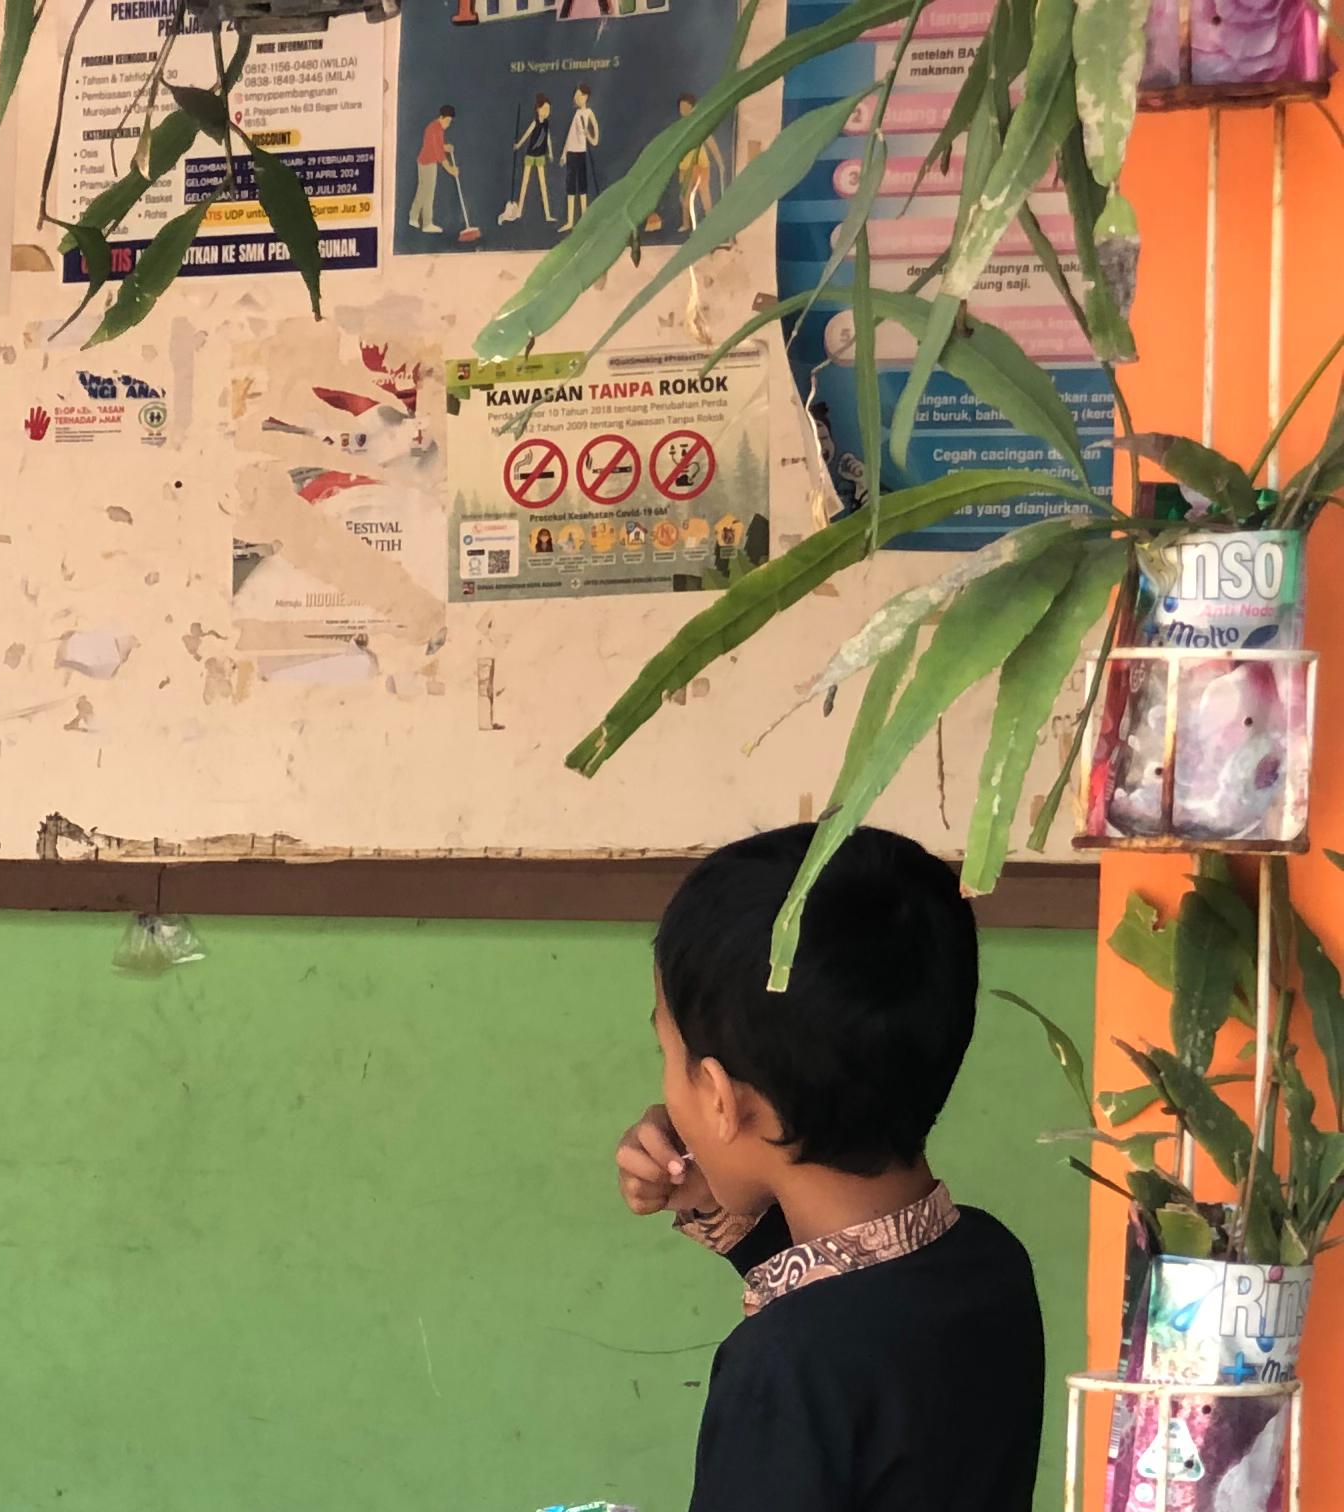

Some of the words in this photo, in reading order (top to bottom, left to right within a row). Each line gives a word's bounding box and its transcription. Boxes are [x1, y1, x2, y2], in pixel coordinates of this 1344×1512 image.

[911, 48, 955, 61] setelah
[957, 46, 981, 59] BA
[319, 56, 358, 70] (WILDA)
[325, 69, 355, 82] (MILA)
[910, 65, 965, 78] makanan
[238, 242, 266, 263] SMK
[1006, 278, 1032, 291] saji.
[486, 384, 584, 407] KAWASAN
[588, 380, 655, 400] TANPA
[659, 375, 729, 397] ROKOK
[561, 407, 589, 417] Tahun
[613, 404, 649, 415] tentang
[650, 400, 700, 411] Perubahan
[701, 397, 728, 408] Perda
[54, 416, 97, 426] TERHADAP
[932, 410, 972, 423] buruk,
[537, 422, 565, 432] Tahun
[589, 419, 624, 430] tentang
[932, 448, 977, 463] Cegah
[980, 447, 1043, 462] cacingan
[976, 502, 1011, 517] yang
[1014, 501, 1093, 516] dianjurkan.
